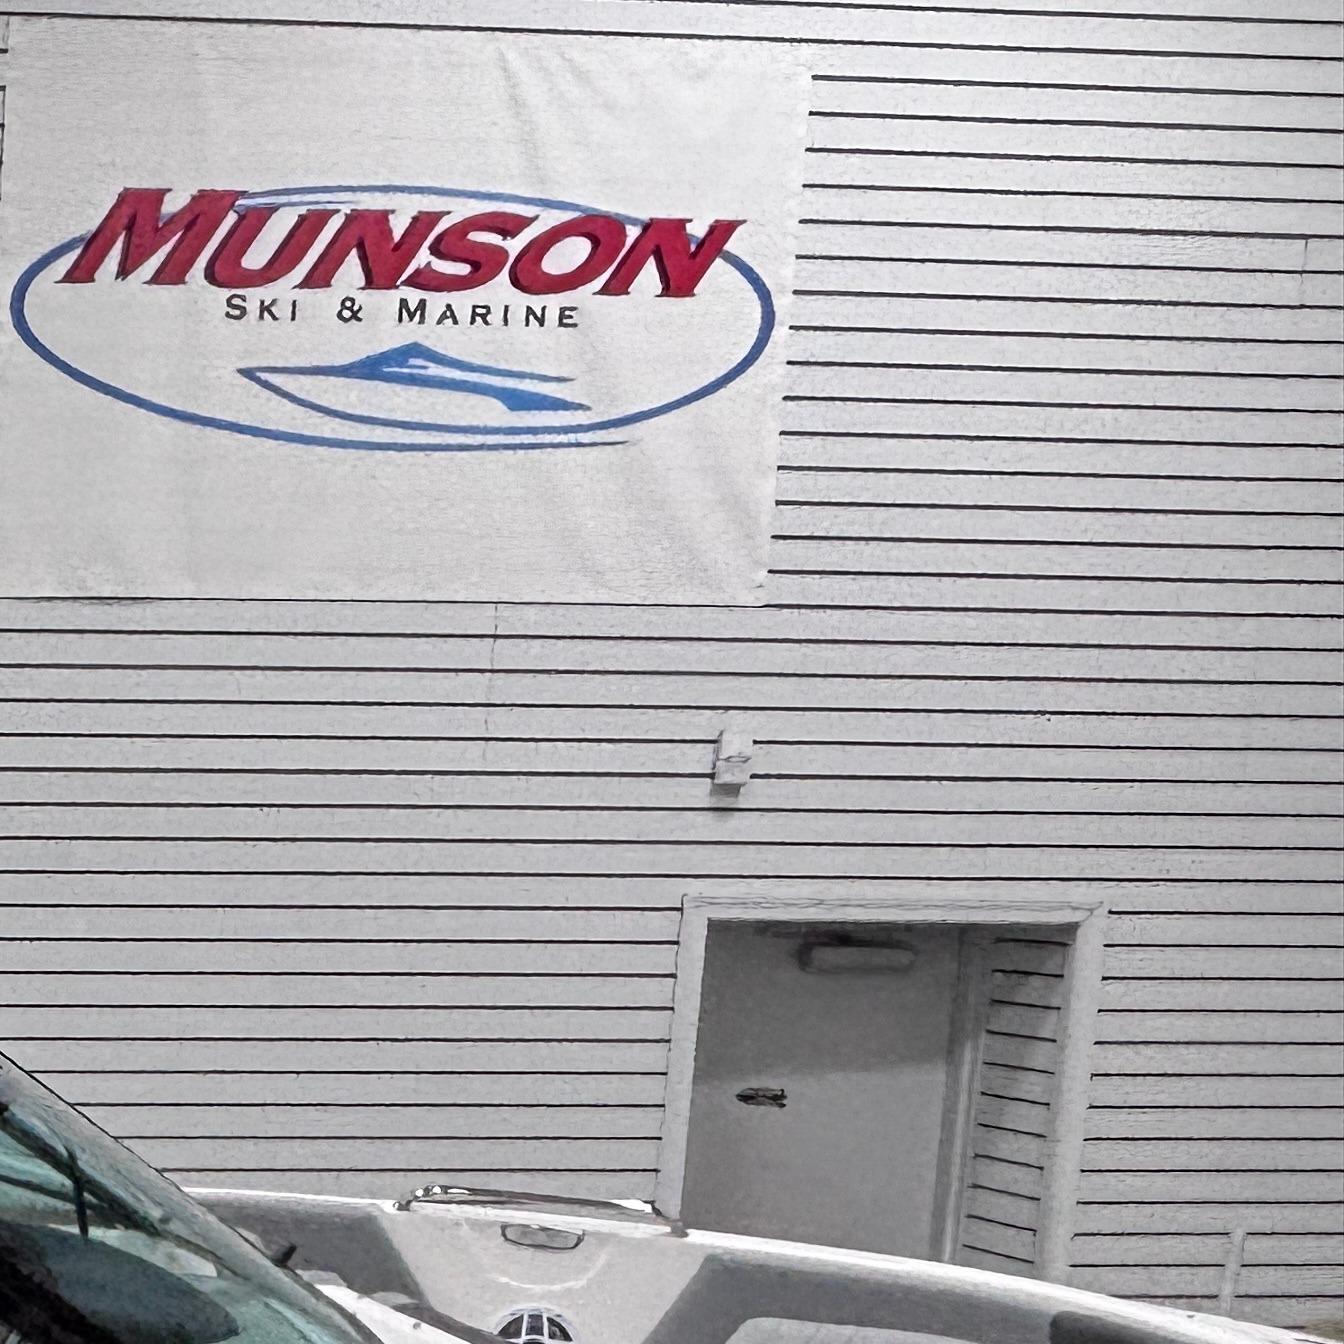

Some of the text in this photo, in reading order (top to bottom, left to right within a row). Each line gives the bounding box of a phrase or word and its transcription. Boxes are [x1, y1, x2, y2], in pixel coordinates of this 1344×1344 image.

[56, 187, 748, 297] MUNSON
[224, 294, 580, 329] SKI & MARINE
